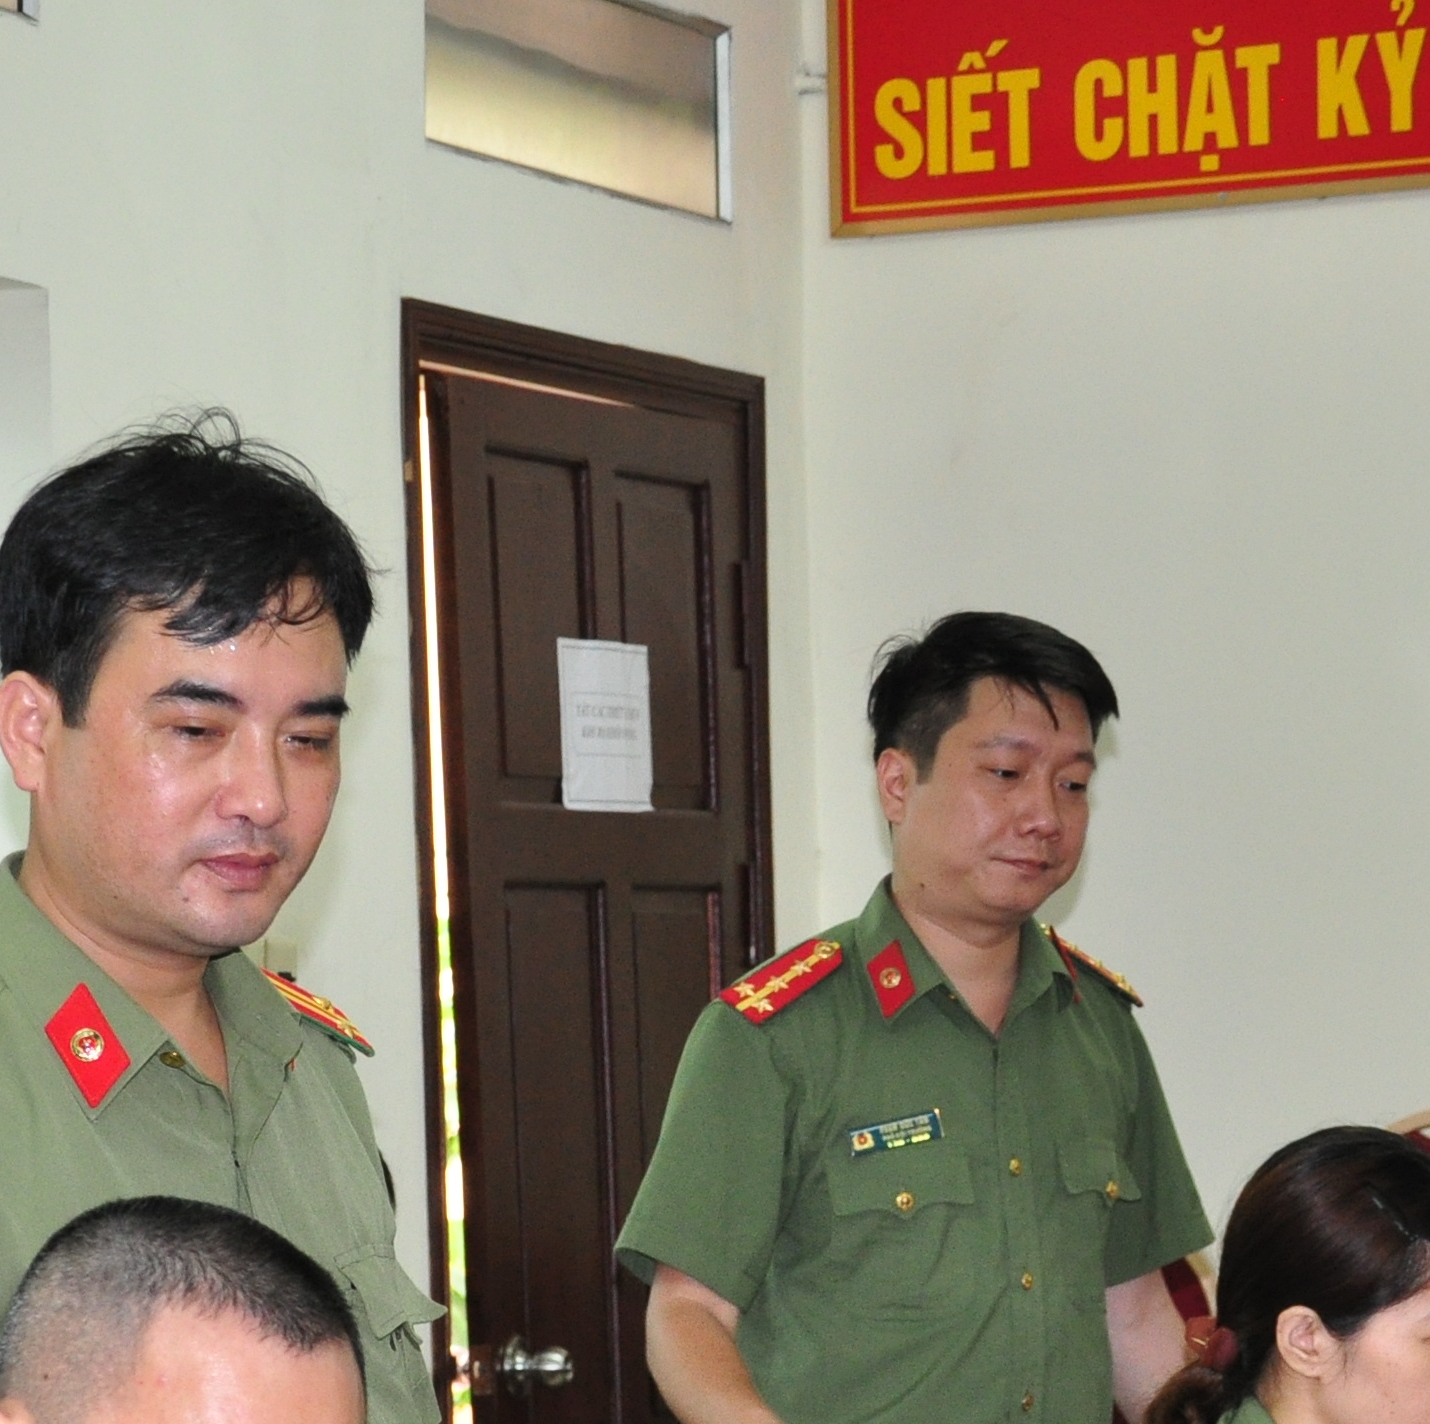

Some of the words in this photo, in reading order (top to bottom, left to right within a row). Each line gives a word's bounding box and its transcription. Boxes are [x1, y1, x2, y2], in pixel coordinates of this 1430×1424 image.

[874, 39, 1041, 179] SIẾT
[1074, 25, 1281, 172] CHẶT
[1317, 0, 1427, 139] KỶ
